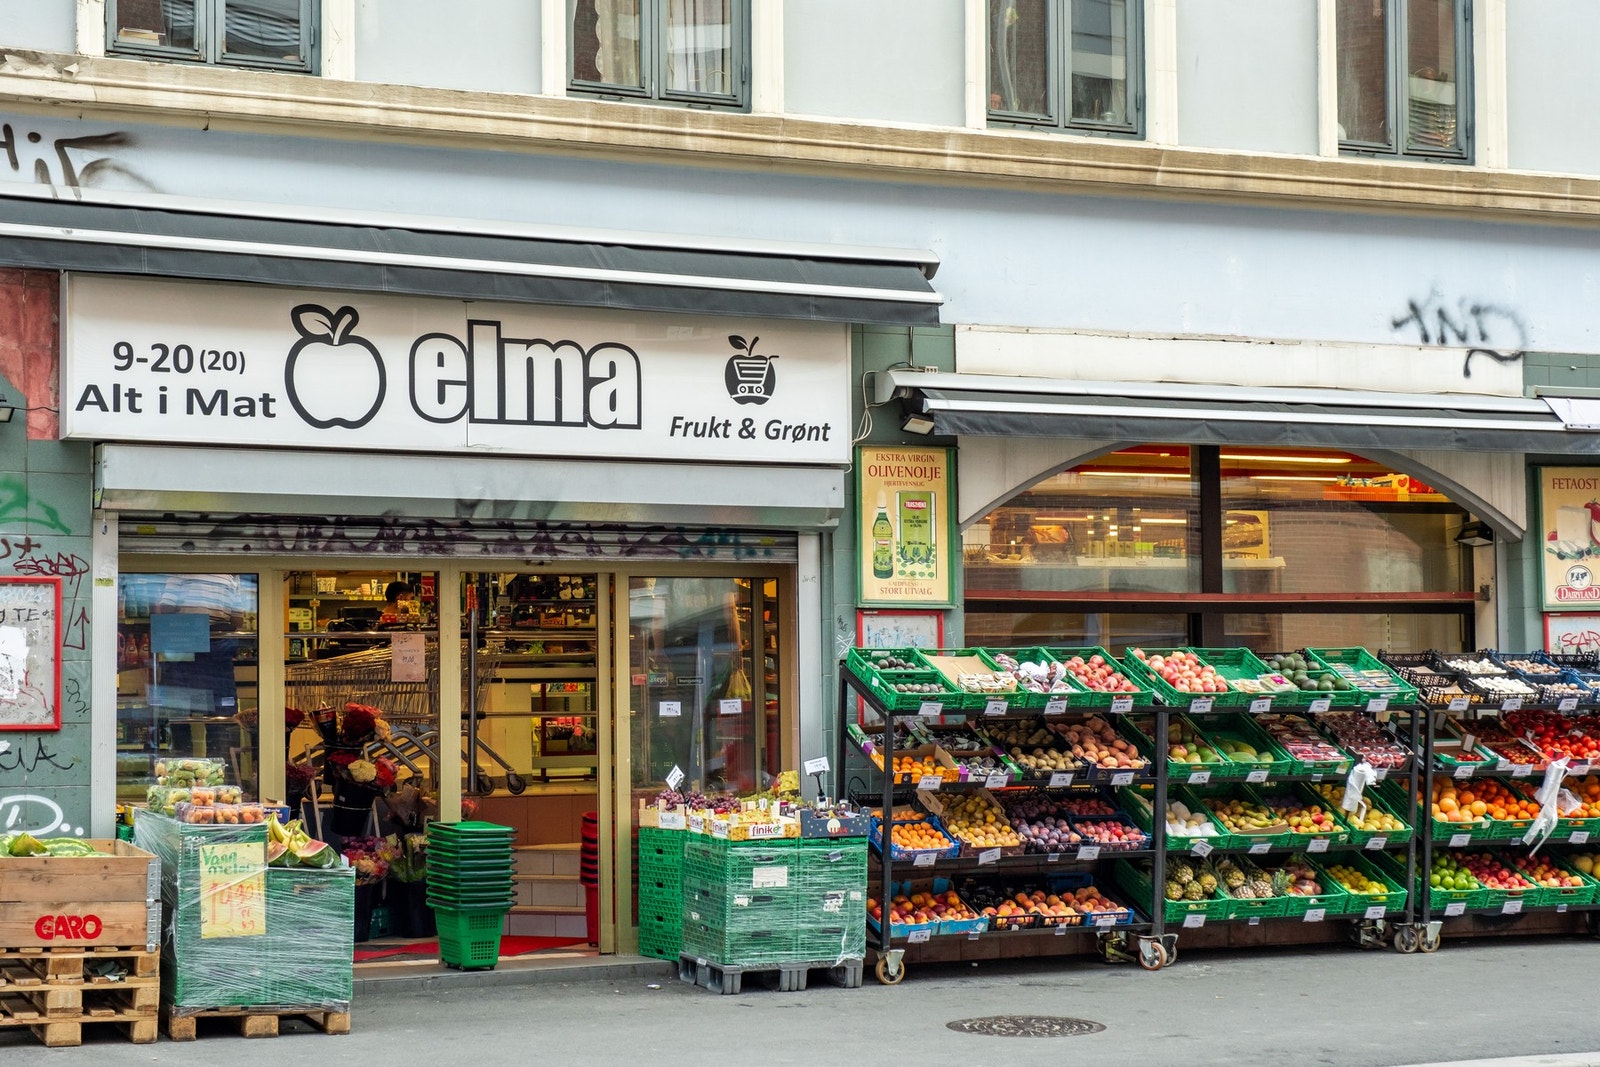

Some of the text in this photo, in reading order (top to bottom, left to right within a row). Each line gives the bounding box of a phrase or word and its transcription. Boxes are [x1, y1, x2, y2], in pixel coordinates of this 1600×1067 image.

[112, 341, 246, 375] 9-20 (20)
[409, 319, 642, 430] elma
[75, 383, 277, 418] Alt i Mat
[669, 416, 831, 443] Frukt & Grønt
[876, 453, 935, 462] EKSTRA VIRGIN
[868, 464, 941, 481] OLIVENOLJE
[1552, 477, 1599, 490] FETAOST
[880, 587, 932, 596] STORT UTVALG
